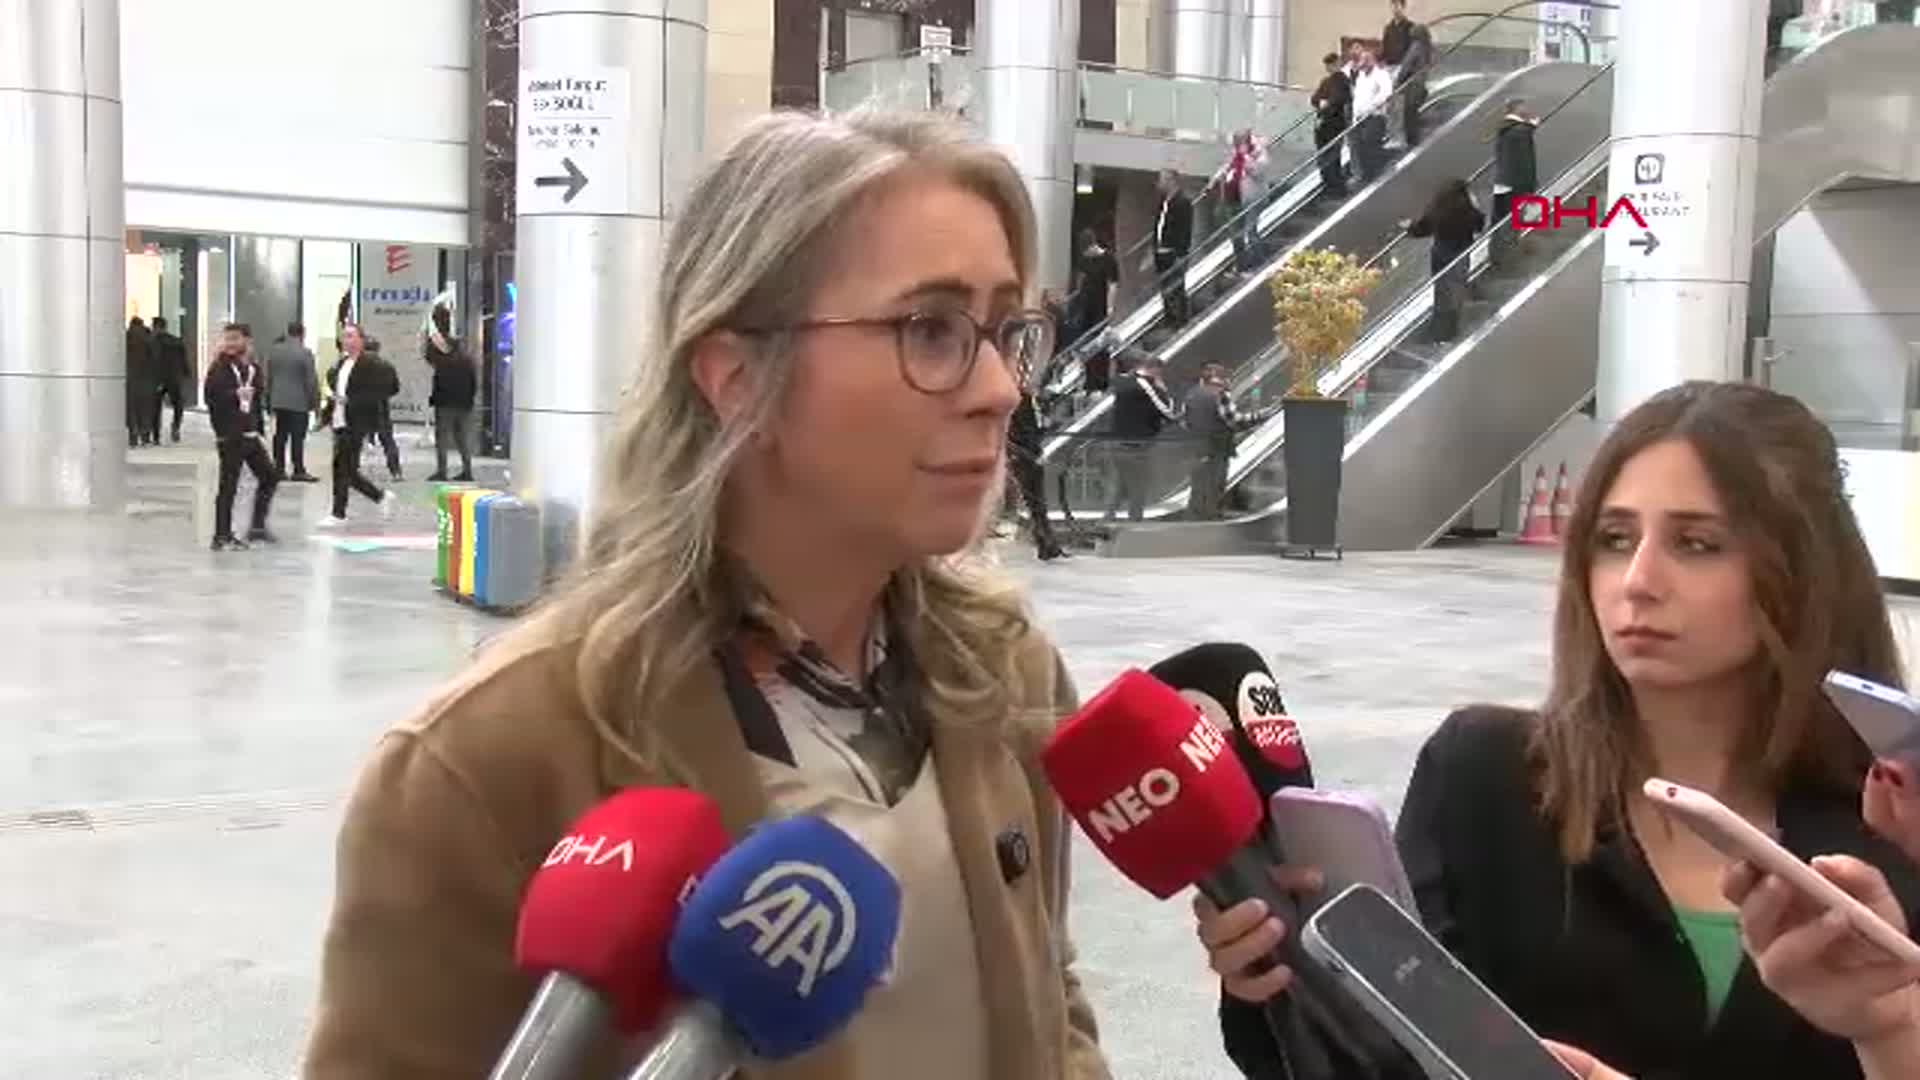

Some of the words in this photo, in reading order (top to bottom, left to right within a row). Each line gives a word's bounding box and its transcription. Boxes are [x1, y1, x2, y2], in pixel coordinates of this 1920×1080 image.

[1087, 767, 1180, 844] NEO
[541, 834, 634, 872] DHA
[718, 882, 835, 998] AA
